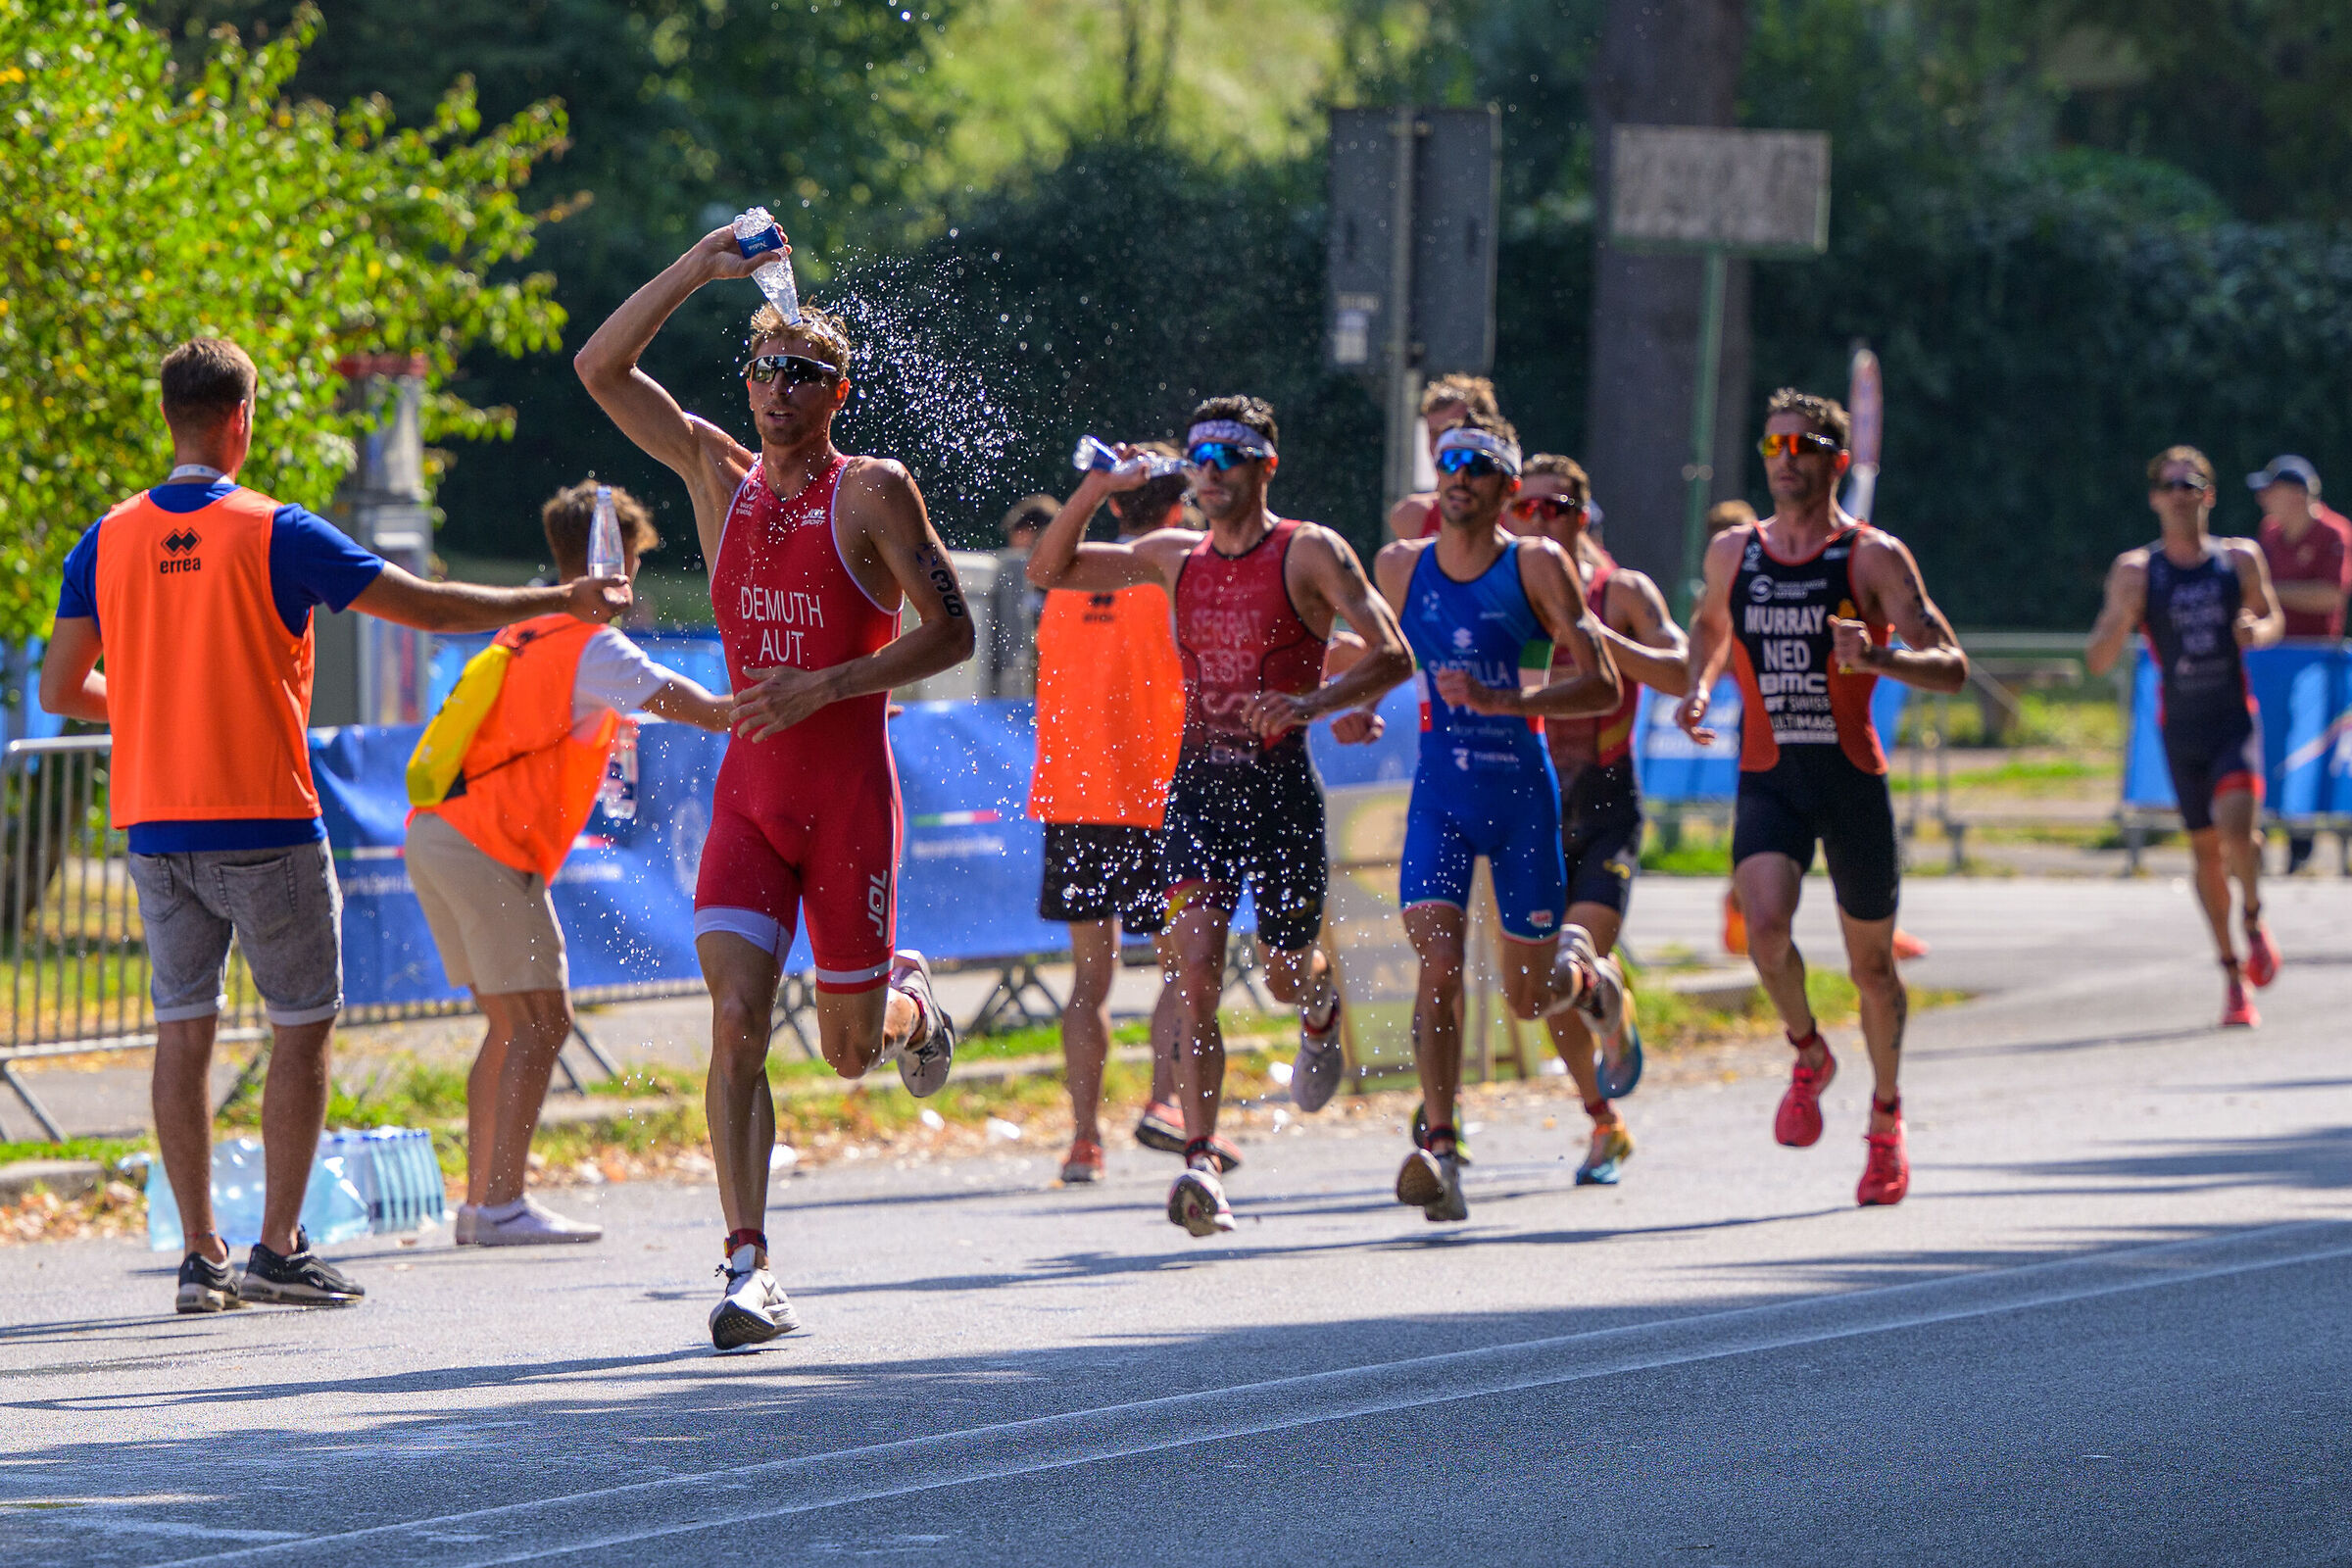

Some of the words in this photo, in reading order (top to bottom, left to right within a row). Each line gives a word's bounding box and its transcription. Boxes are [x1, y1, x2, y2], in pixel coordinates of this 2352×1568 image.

[160, 556, 201, 574] errea
[741, 586, 824, 628] DEMUTH
[930, 568, 965, 619] 36
[1744, 605, 1827, 635] MURRAY
[759, 628, 805, 665] AUT
[1762, 638, 1811, 672] NED
[1200, 649, 1257, 683] ESP
[867, 869, 888, 938] JOL
